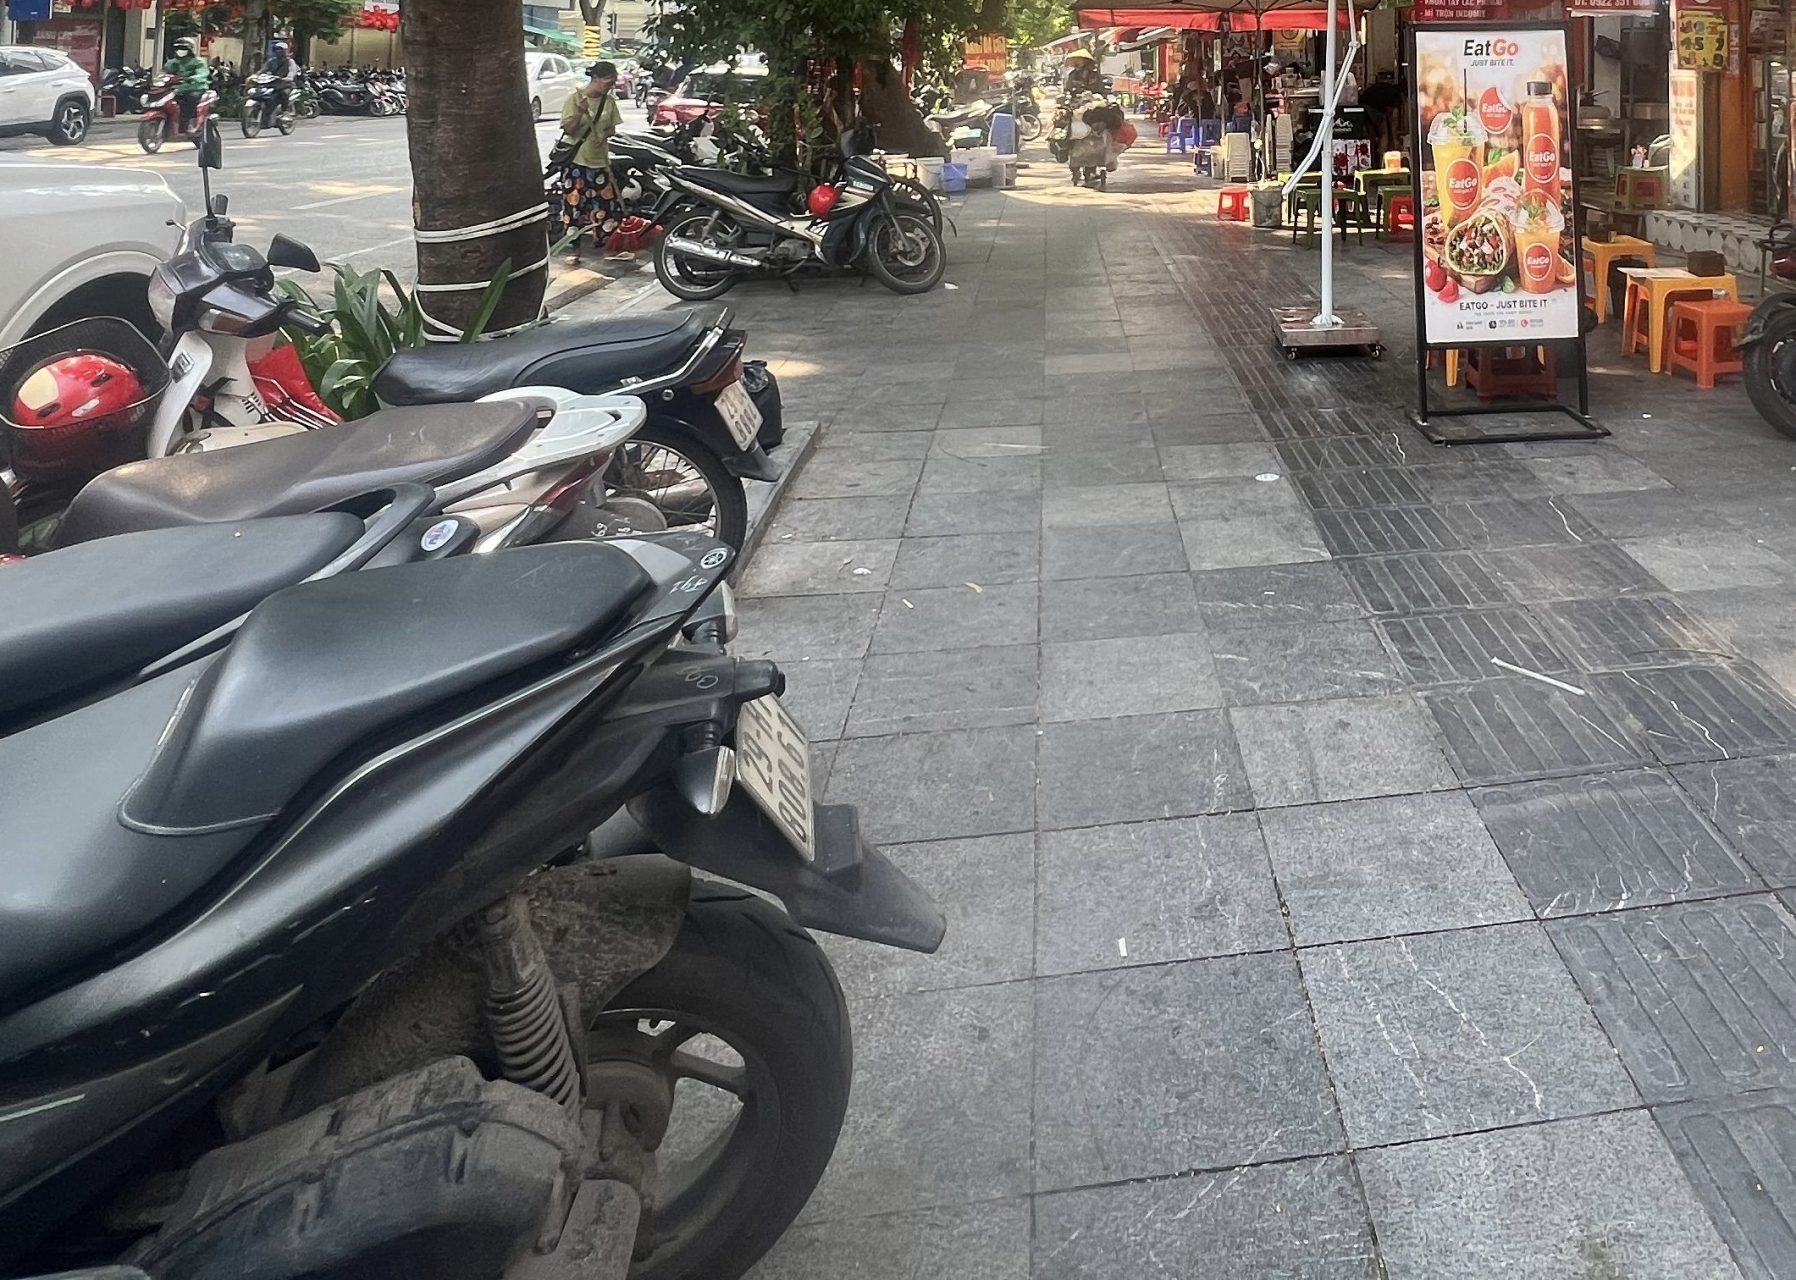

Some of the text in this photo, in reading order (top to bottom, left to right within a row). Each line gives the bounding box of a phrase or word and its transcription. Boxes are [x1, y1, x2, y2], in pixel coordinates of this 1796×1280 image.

[1463, 38, 1519, 56] EatGo
[1471, 59, 1488, 67] JUST
[1529, 151, 1555, 163] EatGo
[1448, 176, 1478, 189] EatGo
[1460, 301, 1489, 311] EATGO
[1496, 301, 1517, 309] JUST
[1520, 300, 1538, 308] BITE
[1540, 300, 1548, 308] IT
